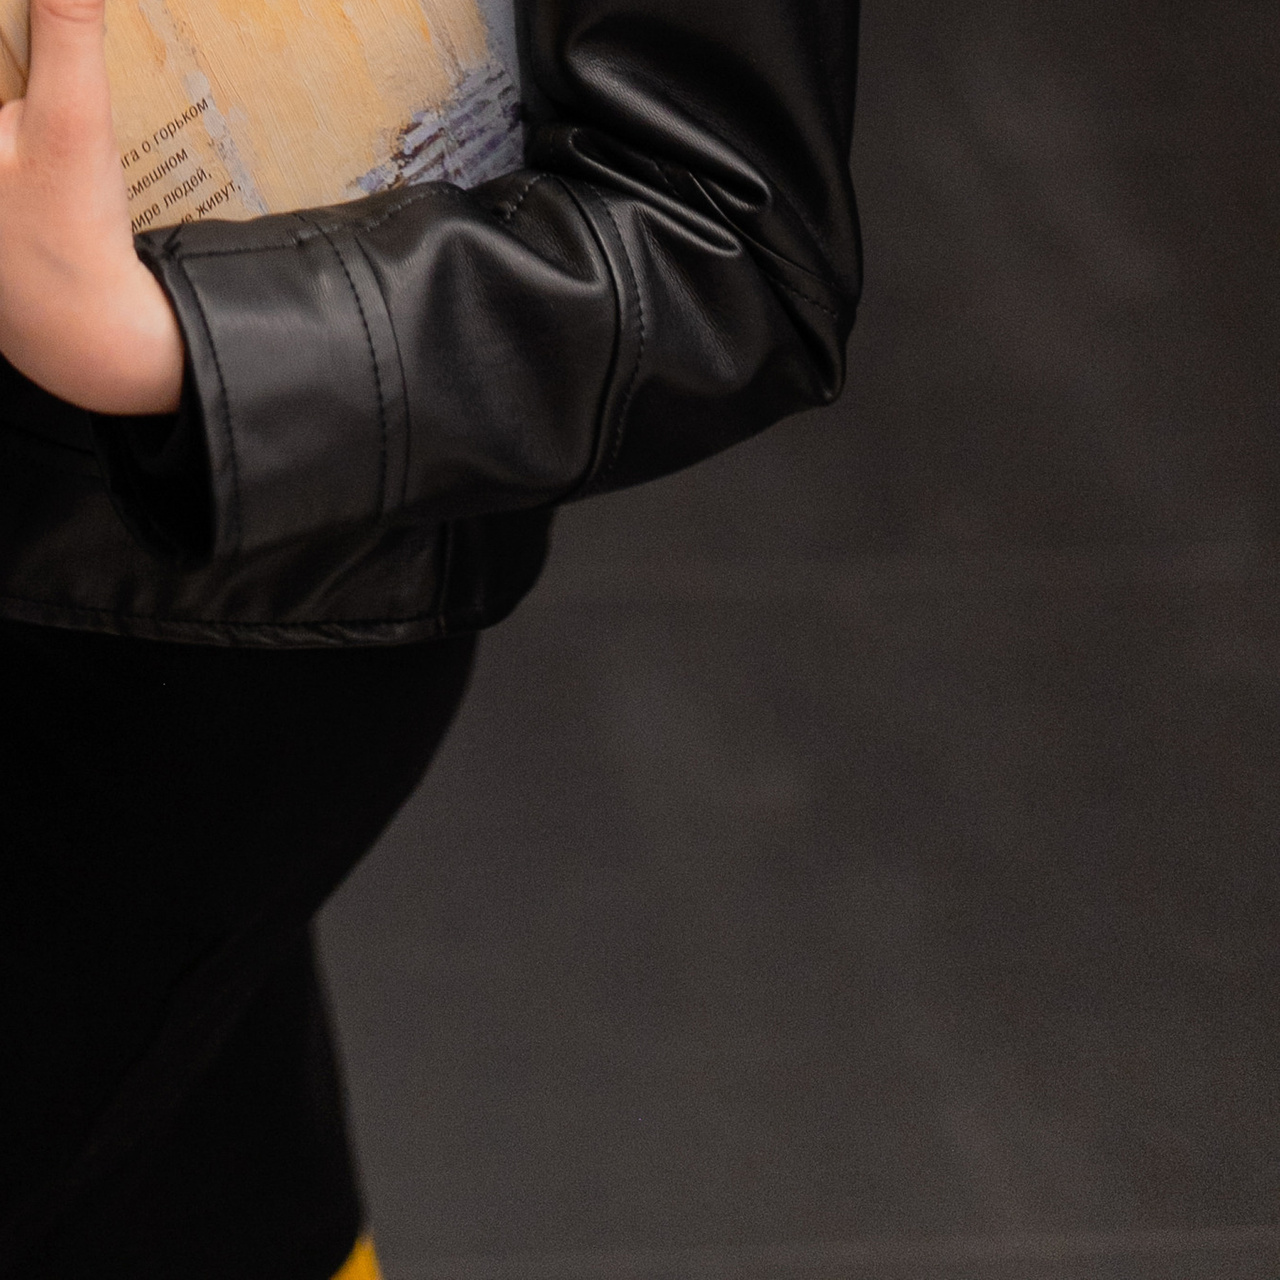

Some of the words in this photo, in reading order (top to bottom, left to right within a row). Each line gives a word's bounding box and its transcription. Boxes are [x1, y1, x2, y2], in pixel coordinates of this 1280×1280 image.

[141, 140, 152, 154] о
[153, 97, 209, 145] горьком
[163, 166, 213, 209] людей,
[195, 180, 242, 218] живут,
